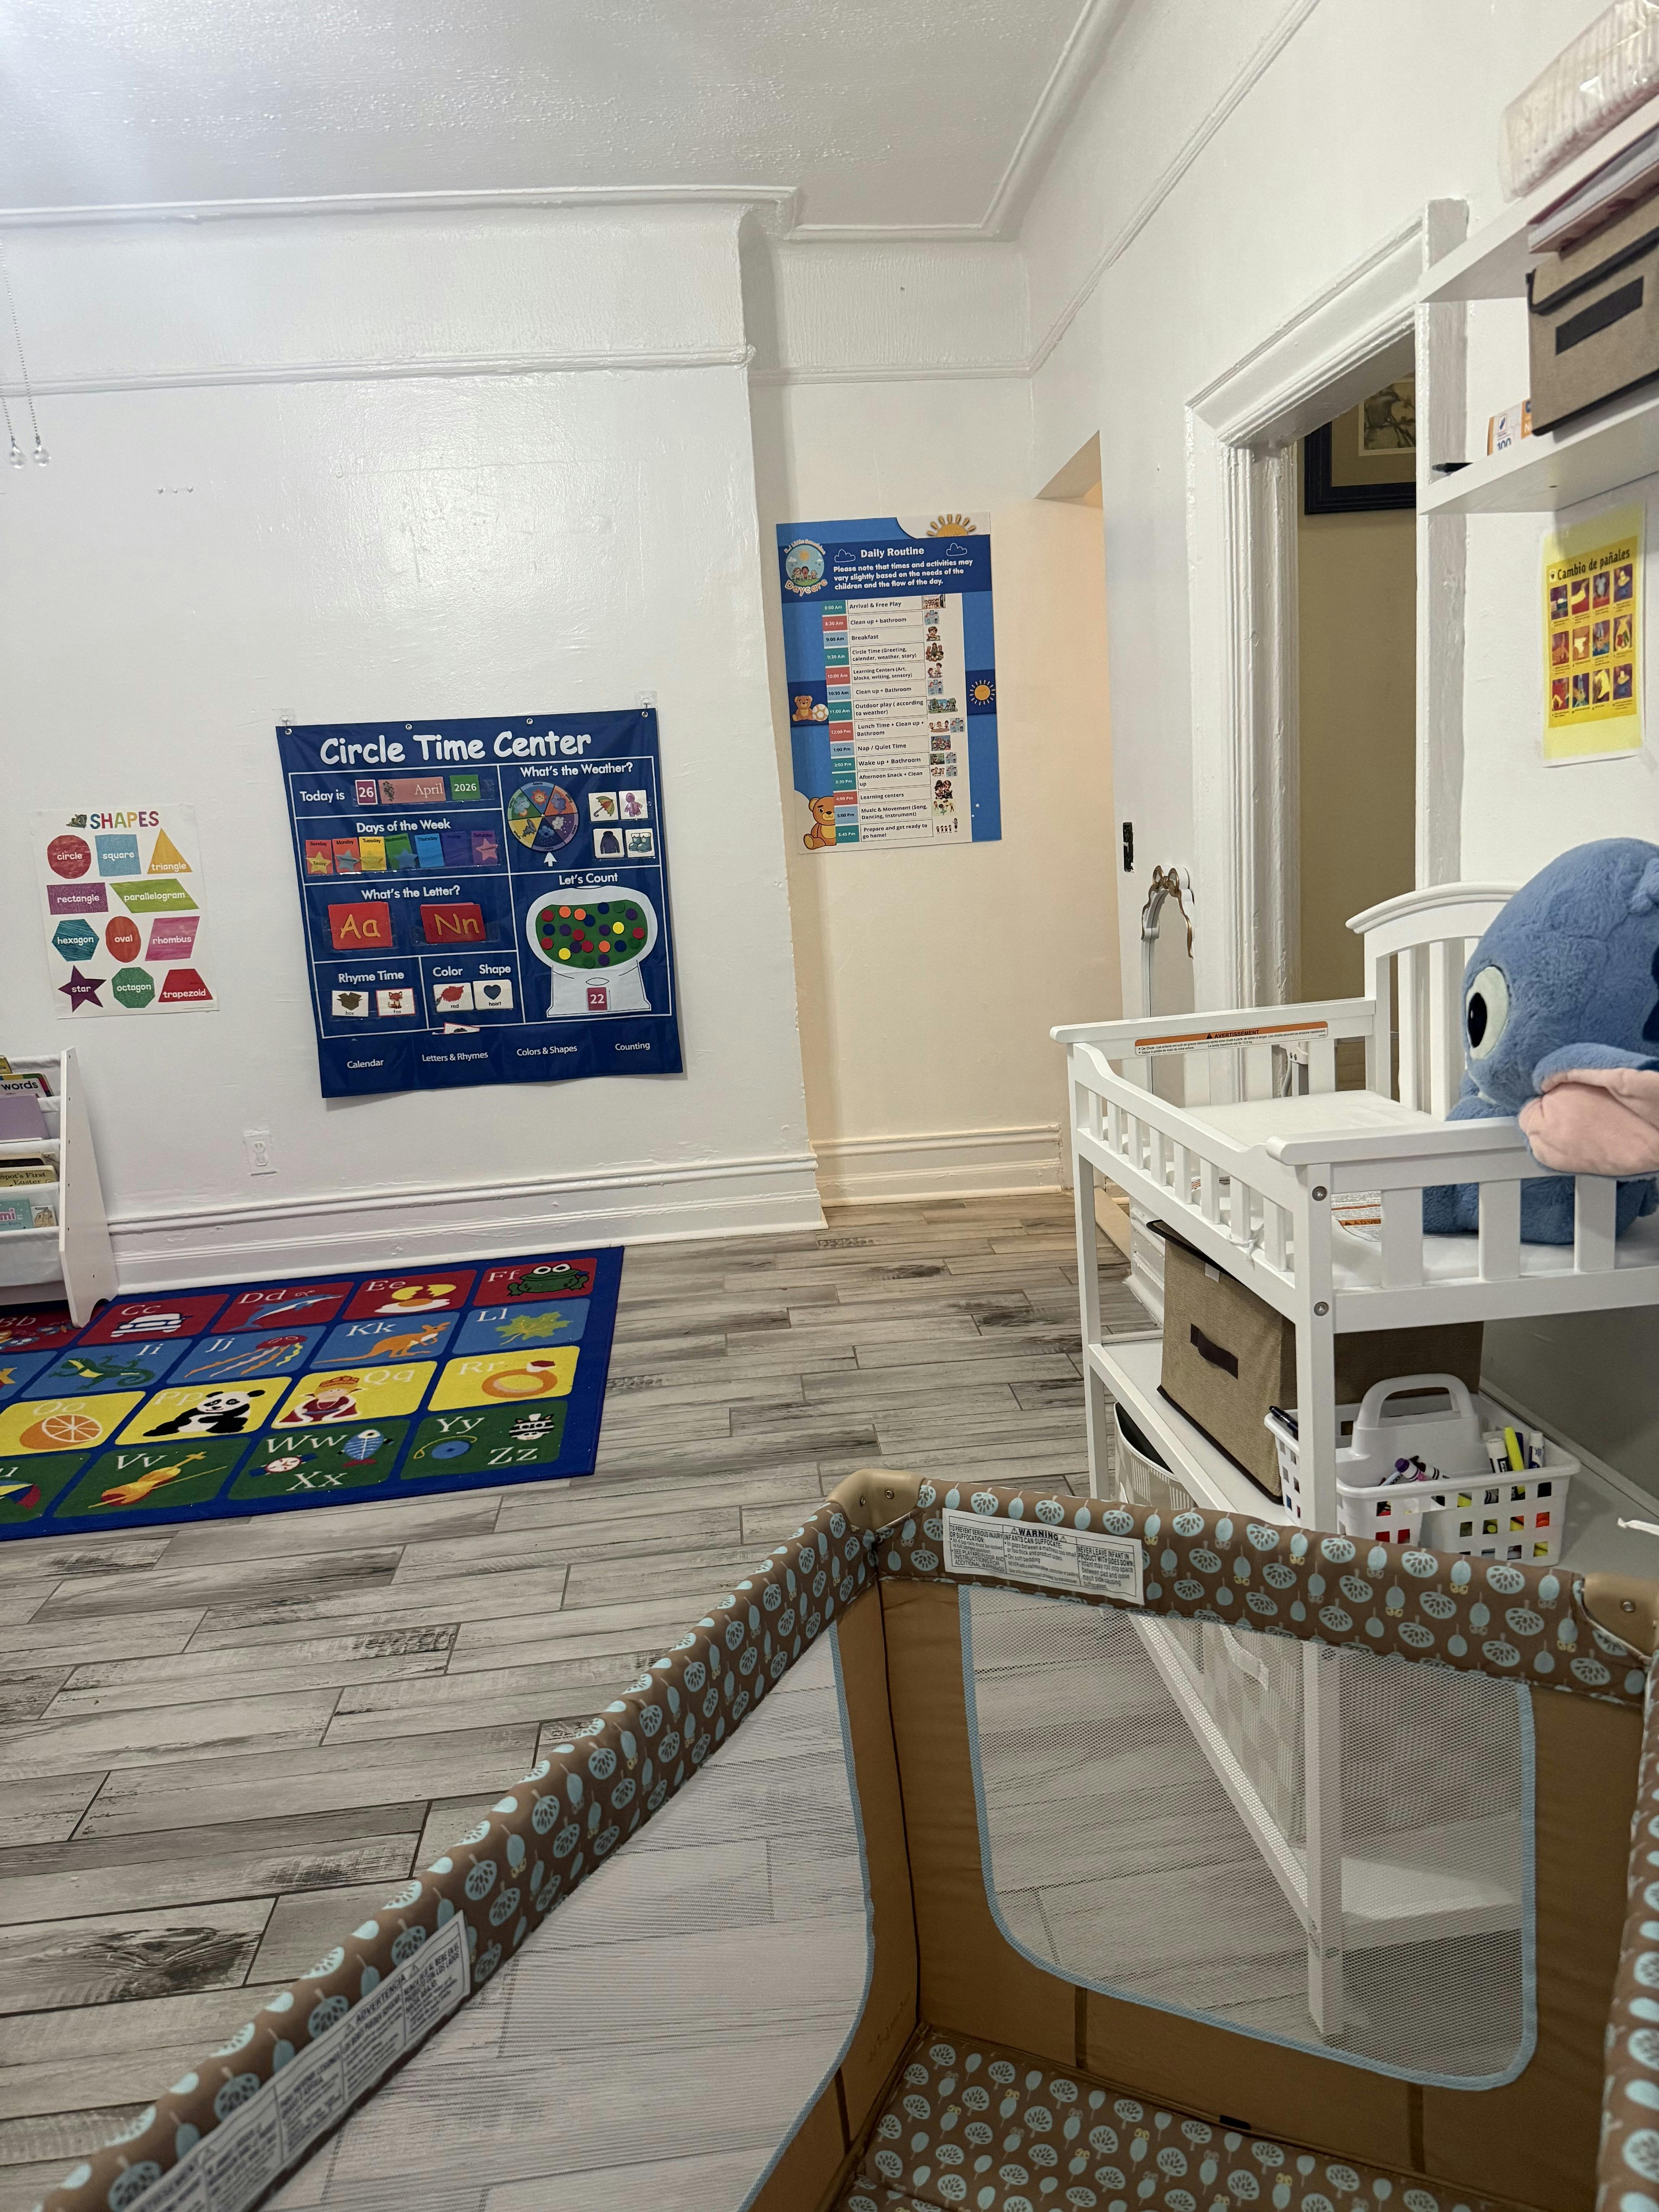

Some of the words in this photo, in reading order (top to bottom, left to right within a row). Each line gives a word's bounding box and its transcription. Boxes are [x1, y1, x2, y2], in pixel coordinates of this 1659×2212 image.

[860, 549, 884, 558] Daily
[887, 547, 924, 556] Routine
[1558, 562, 1585, 580] Cambio
[1589, 558, 1597, 571] de
[1600, 549, 1630, 570] pañales
[850, 573, 874, 581] slightly
[785, 579, 828, 596] Daycare
[320, 735, 405, 764] Circle
[413, 734, 485, 761] Time
[493, 731, 592, 757] Center
[520, 766, 558, 777] What's
[561, 765, 578, 776] the
[580, 762, 633, 775] Weather?
[300, 790, 333, 803] Today
[336, 790, 345, 800] is
[359, 787, 373, 798] 26
[414, 784, 443, 798] April
[454, 783, 477, 792] 2026
[90, 811, 159, 829] SHAPES
[356, 822, 384, 835] Days
[387, 821, 397, 831] of
[399, 820, 417, 831] the
[419, 819, 451, 830] Week
[57, 852, 82, 860] circle
[102, 852, 134, 861] square
[151, 862, 187, 872] triangle
[559, 874, 583, 885] Let's
[586, 873, 618, 883] Count
[124, 891, 185, 902] parallelogram
[361, 888, 400, 900] What's
[403, 888, 420, 898] the
[423, 885, 460, 897] Letter?
[57, 895, 100, 904] rectangle
[340, 914, 381, 939] Aa
[434, 914, 480, 935] Nn
[57, 936, 94, 946] hexagon
[114, 934, 133, 943] oval
[153, 936, 192, 944] rhombus
[433, 966, 463, 977] Color
[479, 964, 511, 975] Shape
[338, 973, 376, 984] Rhyme
[377, 970, 404, 981] Time
[117, 983, 151, 993] octagon
[163, 989, 206, 999] trapezoid
[590, 994, 605, 1005] 22
[1214, 1029, 1259, 1039] AVERTISSEMENT
[516, 1048, 541, 1056] Colors
[550, 1046, 577, 1055] Shapes
[615, 1042, 650, 1051] Counting
[457, 1051, 488, 1061] Rhymes
[347, 1059, 384, 1068] Calendar
[1, 1081, 38, 1090] words
[487, 1269, 520, 1282] Ff
[365, 1280, 406, 1292] Ee
[239, 1290, 287, 1304] Dd
[121, 1304, 161, 1316] Cc
[476, 1308, 509, 1322] Ll
[346, 1322, 395, 1337] Kk
[135, 1343, 165, 1356] Ii
[205, 1338, 235, 1352] Jj
[459, 1360, 505, 1375] Rr
[364, 1369, 416, 1384] Qq
[155, 1391, 204, 1408] Pp
[33, 1401, 85, 1416] Oo
[436, 1416, 485, 1435] Yy
[266, 1434, 348, 1453] Ww
[116, 1453, 168, 1470] Vv
[487, 1446, 539, 1466] Zz
[287, 1471, 348, 1491] Xx
[957, 1533, 985, 1543] SUFFOCATION:
[1018, 1528, 1058, 1541] WARNING
[1004, 1534, 1023, 1542] INFANTS
[1035, 1539, 1062, 1549] SUFFOCATE:
[357, 1974, 406, 2023] ADVERTENCIA
